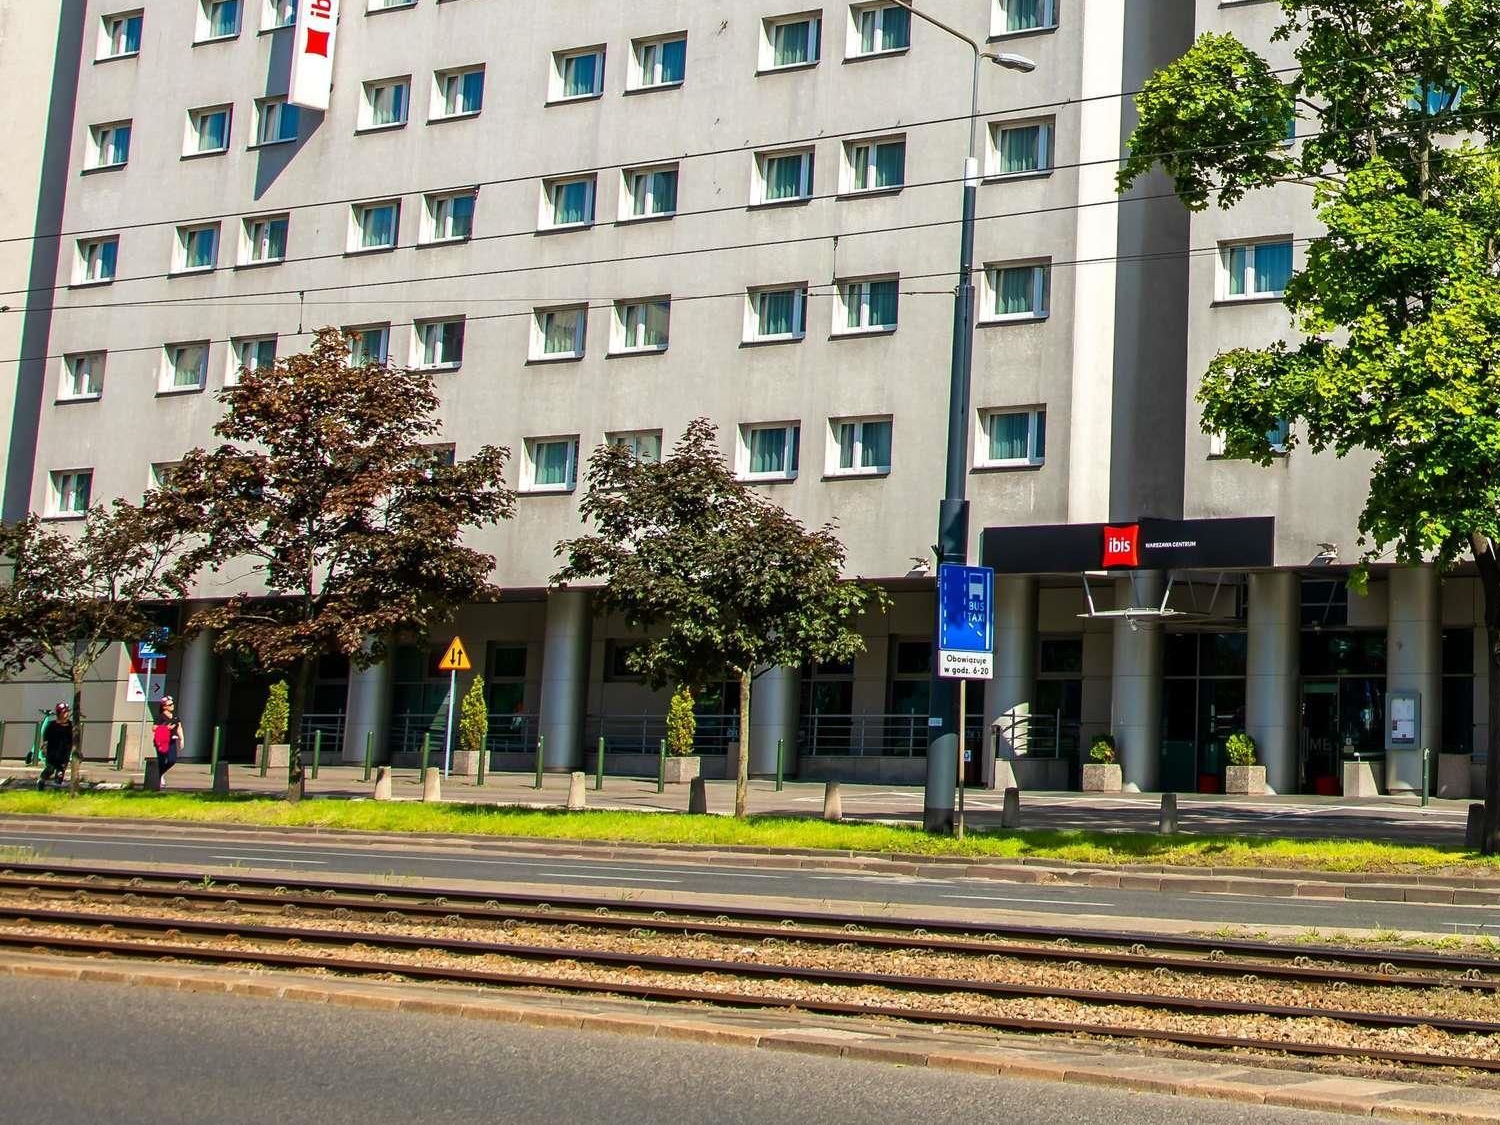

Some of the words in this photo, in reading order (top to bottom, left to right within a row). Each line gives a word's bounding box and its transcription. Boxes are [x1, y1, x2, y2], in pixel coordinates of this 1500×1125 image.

[1108, 537, 1131, 553] ibis
[968, 601, 985, 612] BUS
[967, 612, 985, 623] TAXI
